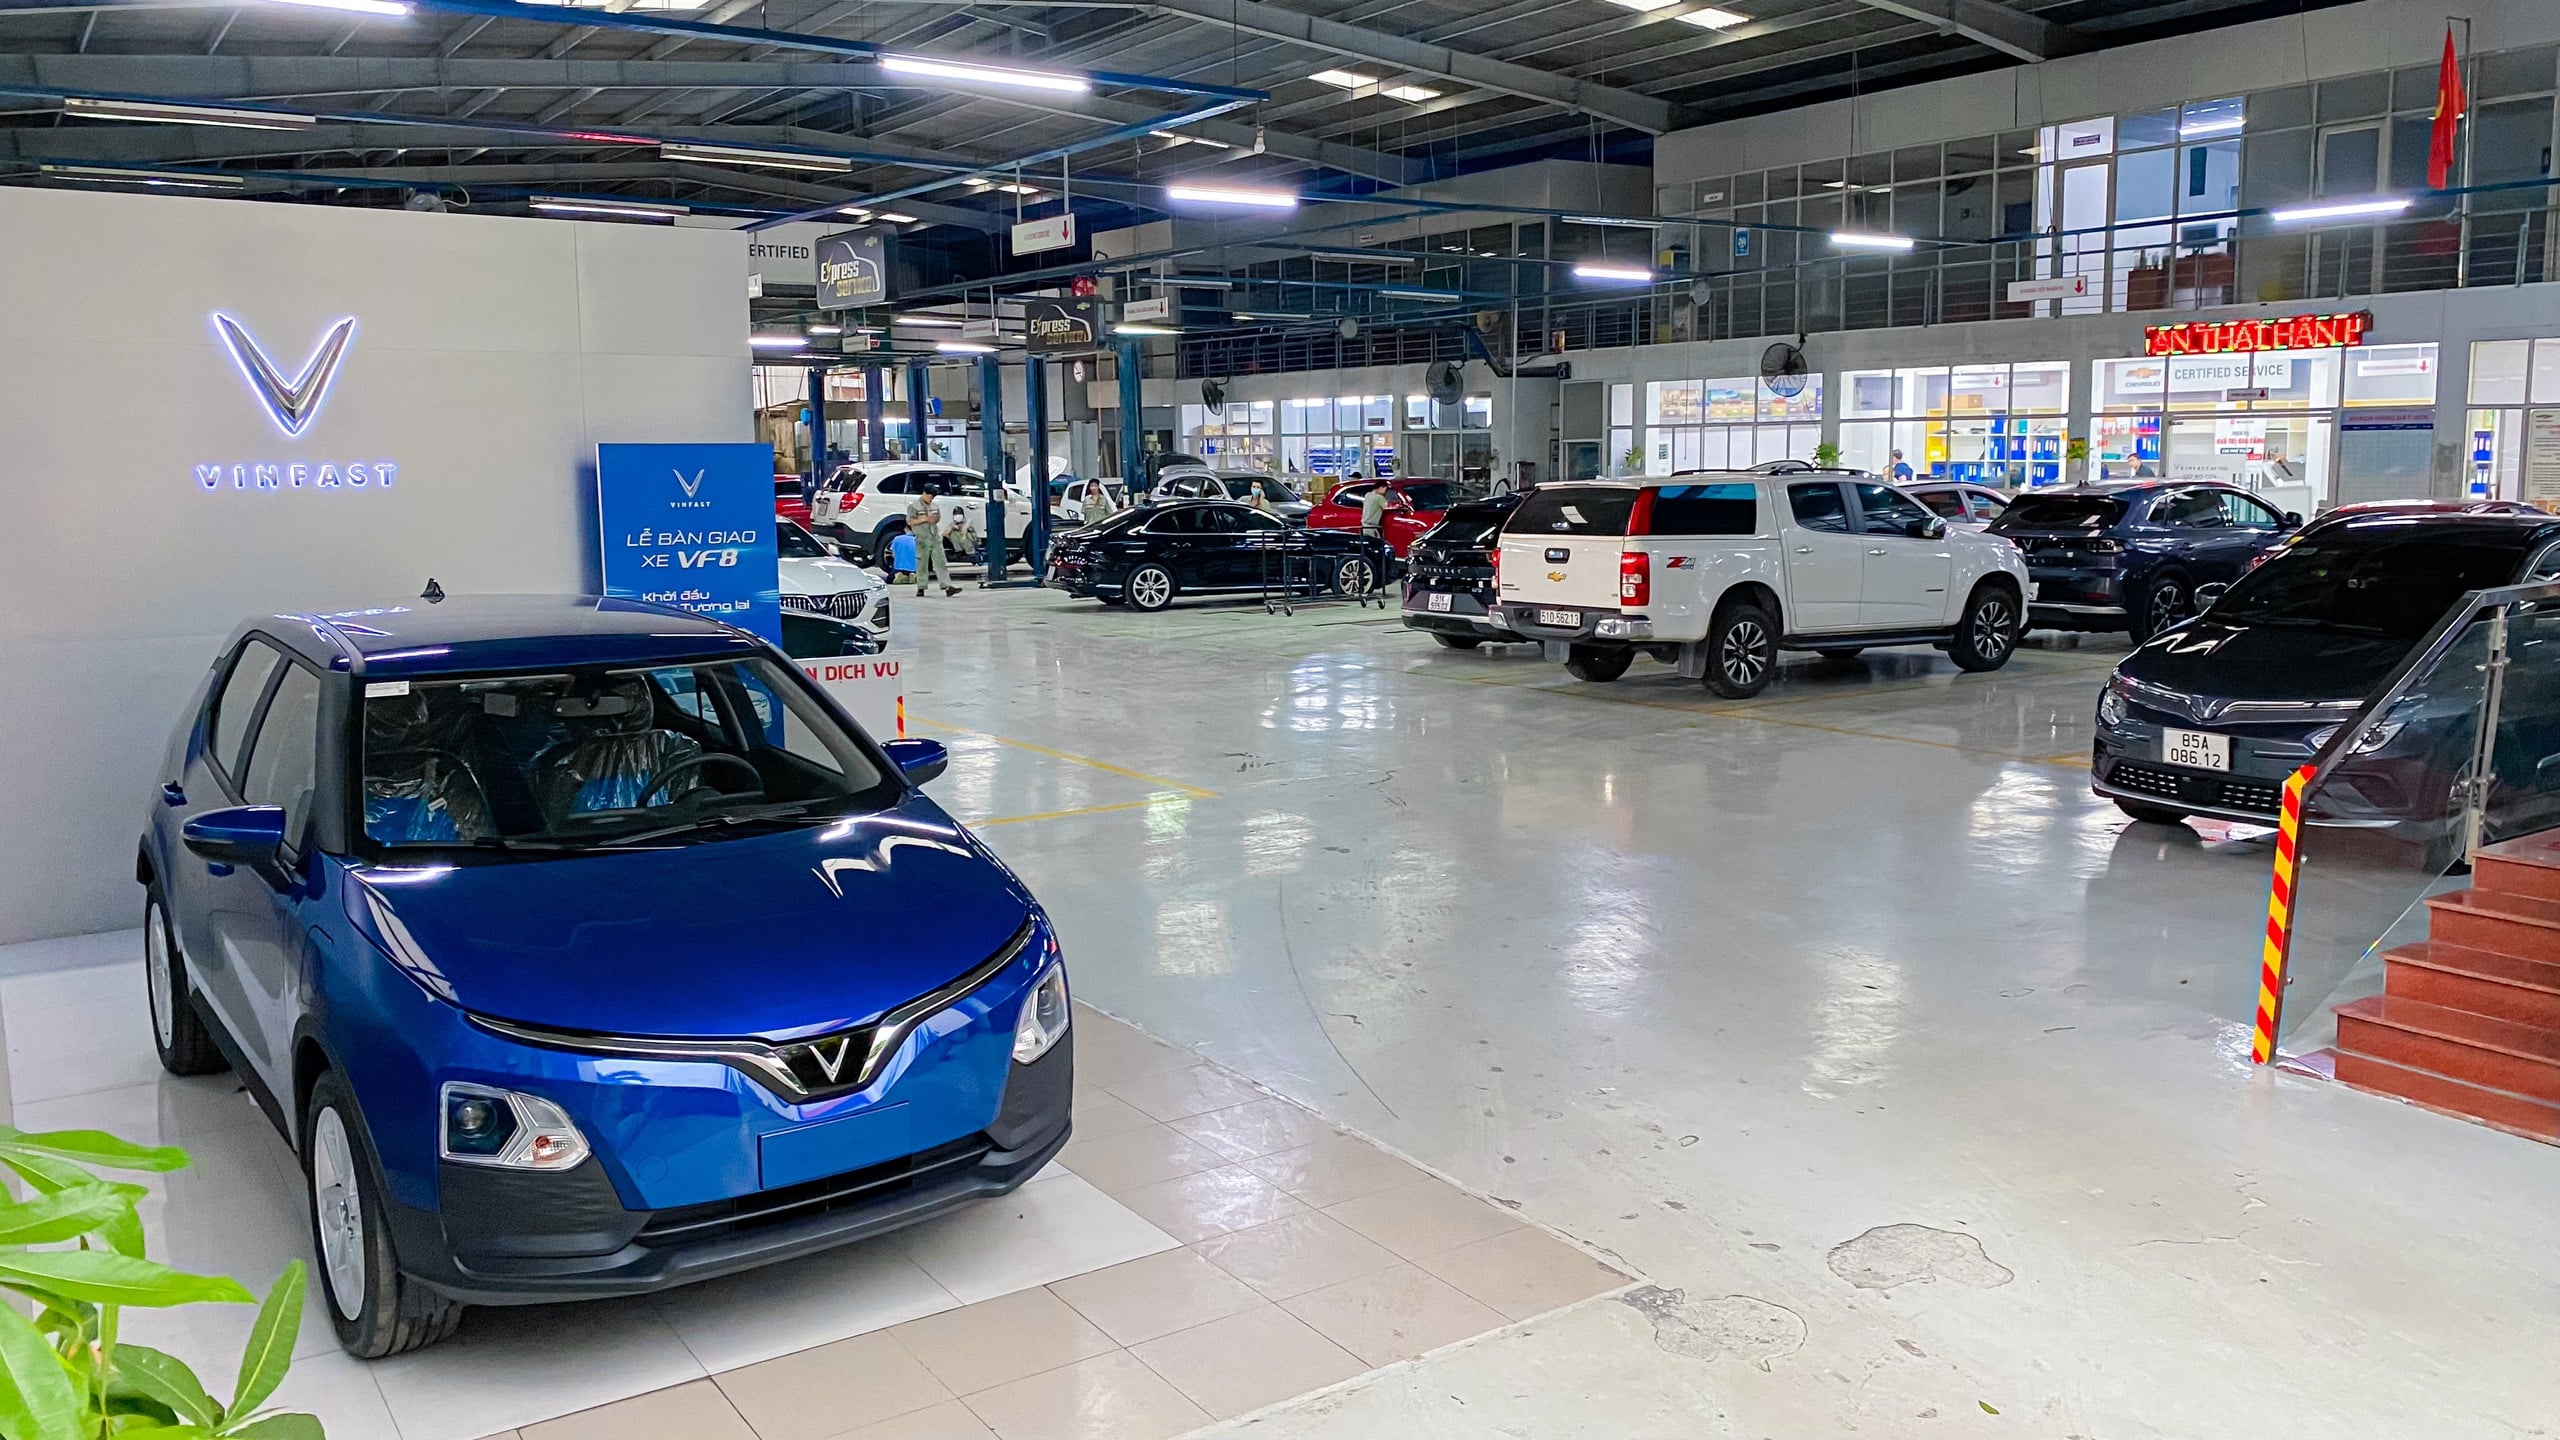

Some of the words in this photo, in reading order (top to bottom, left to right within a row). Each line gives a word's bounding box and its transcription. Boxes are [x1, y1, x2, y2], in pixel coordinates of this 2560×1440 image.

[749, 244, 809, 259] ERTIFIED
[820, 260, 860, 284] Express
[1030, 319, 1071, 335] Express
[2174, 367, 2231, 380] CERTIFIED
[2234, 364, 2284, 378] SEVICE
[197, 464, 396, 488] VINFAST
[626, 528, 653, 547] LỄ
[658, 529, 703, 546] BÀN
[708, 530, 756, 544] GIAO
[641, 554, 670, 567] XE
[677, 549, 738, 569] VF8
[735, 600, 750, 609] lai
[825, 664, 866, 683] DỊCH
[873, 661, 899, 680] VỤ
[2182, 733, 2209, 750] 85A
[2171, 748, 2221, 768] 086.12
